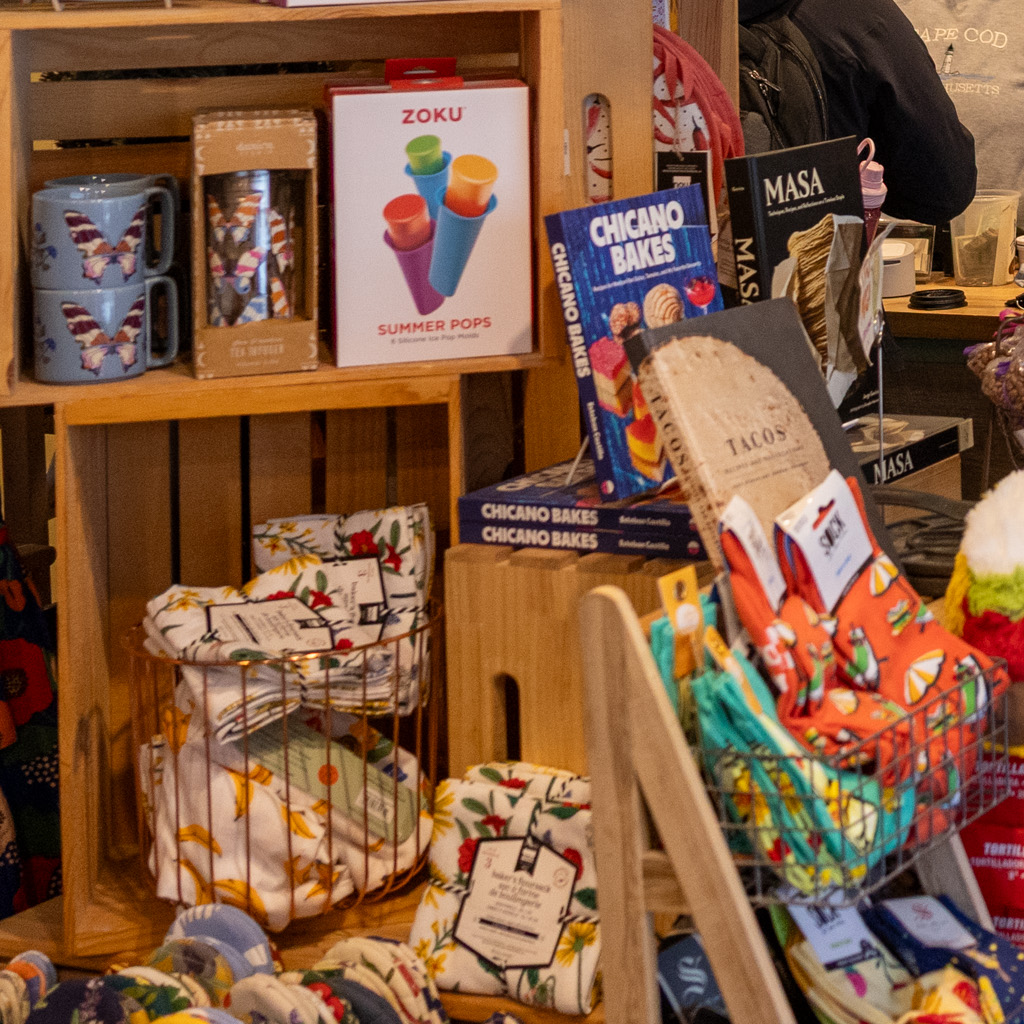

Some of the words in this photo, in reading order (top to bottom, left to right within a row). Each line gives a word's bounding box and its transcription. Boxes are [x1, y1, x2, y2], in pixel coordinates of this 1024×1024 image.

[915, 28, 959, 42] APE
[964, 27, 1008, 49] COD
[402, 107, 463, 124] ZOKU
[763, 167, 825, 207] MASA
[589, 200, 684, 248] CHICANO
[610, 233, 676, 276] BAKES
[378, 320, 445, 335] SUMMER
[450, 317, 492, 330] POPS
[551, 243, 580, 323] CHICANO
[567, 322, 592, 378] BAKES
[726, 424, 787, 457] TACOS
[873, 450, 914, 485] MASA
[481, 503, 550, 523] CHICANO
[551, 507, 599, 526] BAKES
[482, 526, 550, 546] CHICANO
[551, 531, 599, 550] BAKES
